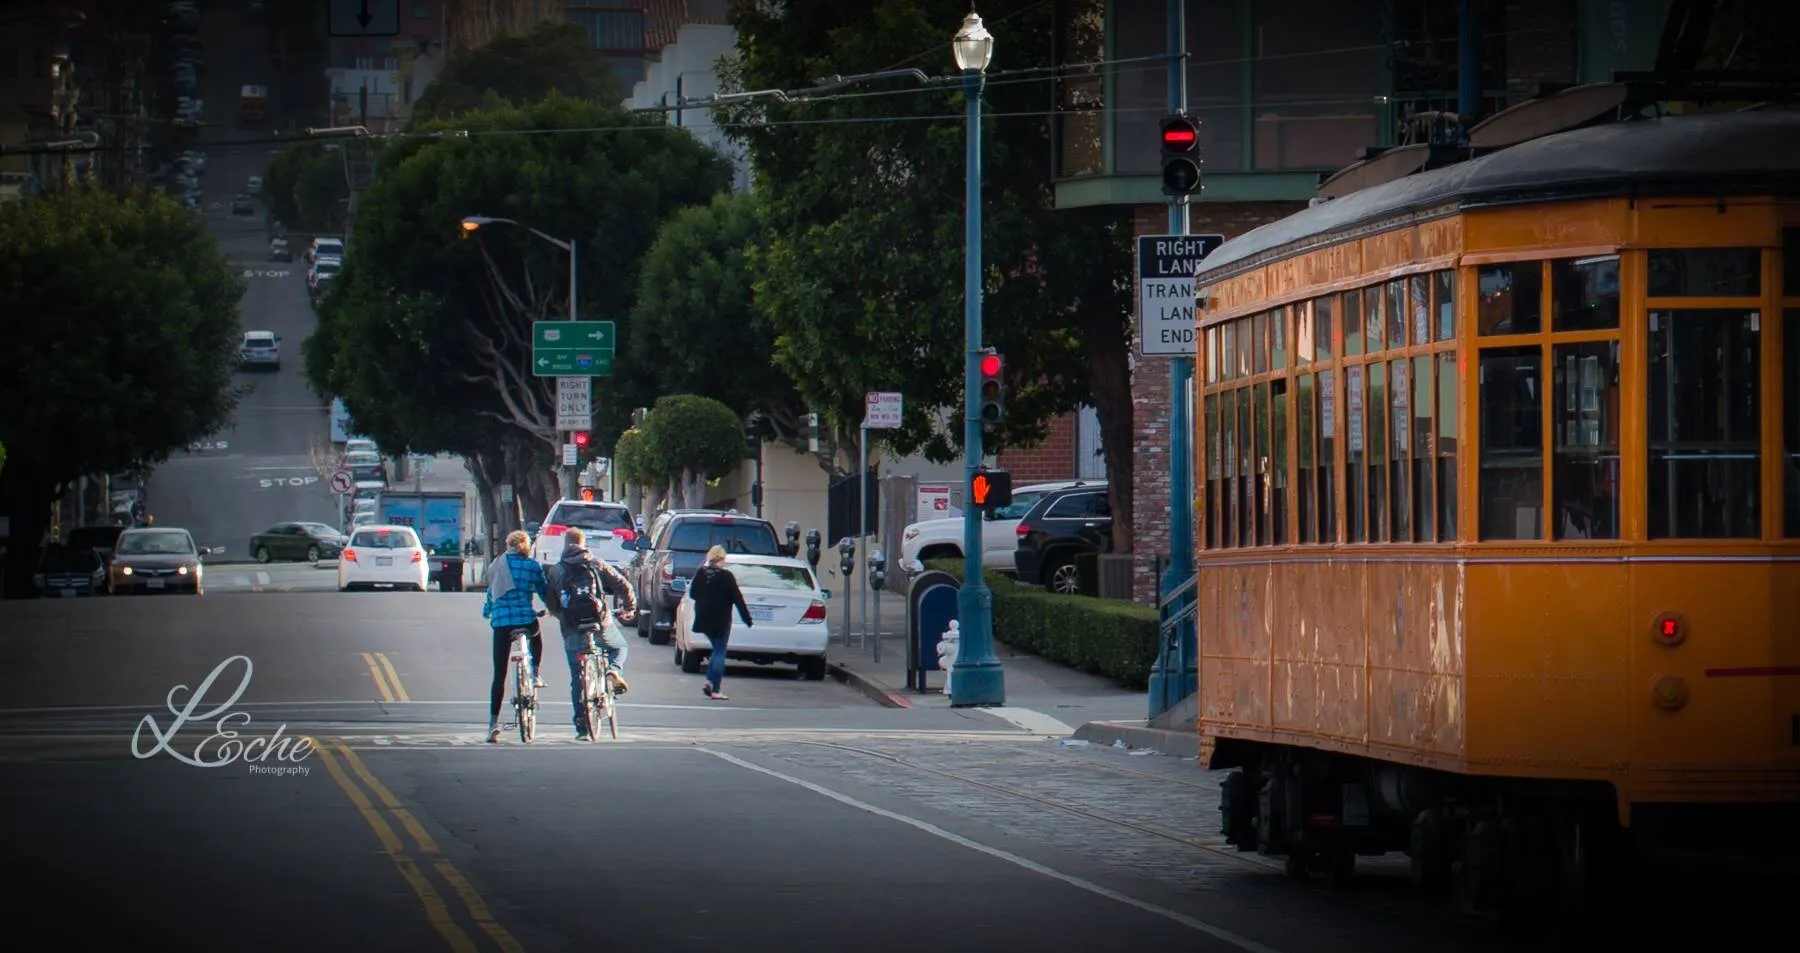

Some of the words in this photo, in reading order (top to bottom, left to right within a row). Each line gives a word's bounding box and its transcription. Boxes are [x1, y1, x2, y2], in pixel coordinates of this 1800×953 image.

[1156, 240, 1206, 256] RIGHT
[243, 270, 290, 278] STOP
[1161, 306, 1193, 320] LAN
[1161, 329, 1196, 343] END
[560, 381, 587, 389] RIGHT
[561, 392, 587, 400] TURN
[560, 404, 586, 412] ONLY
[259, 476, 319, 488] STOP
[389, 517, 414, 526] FREE
